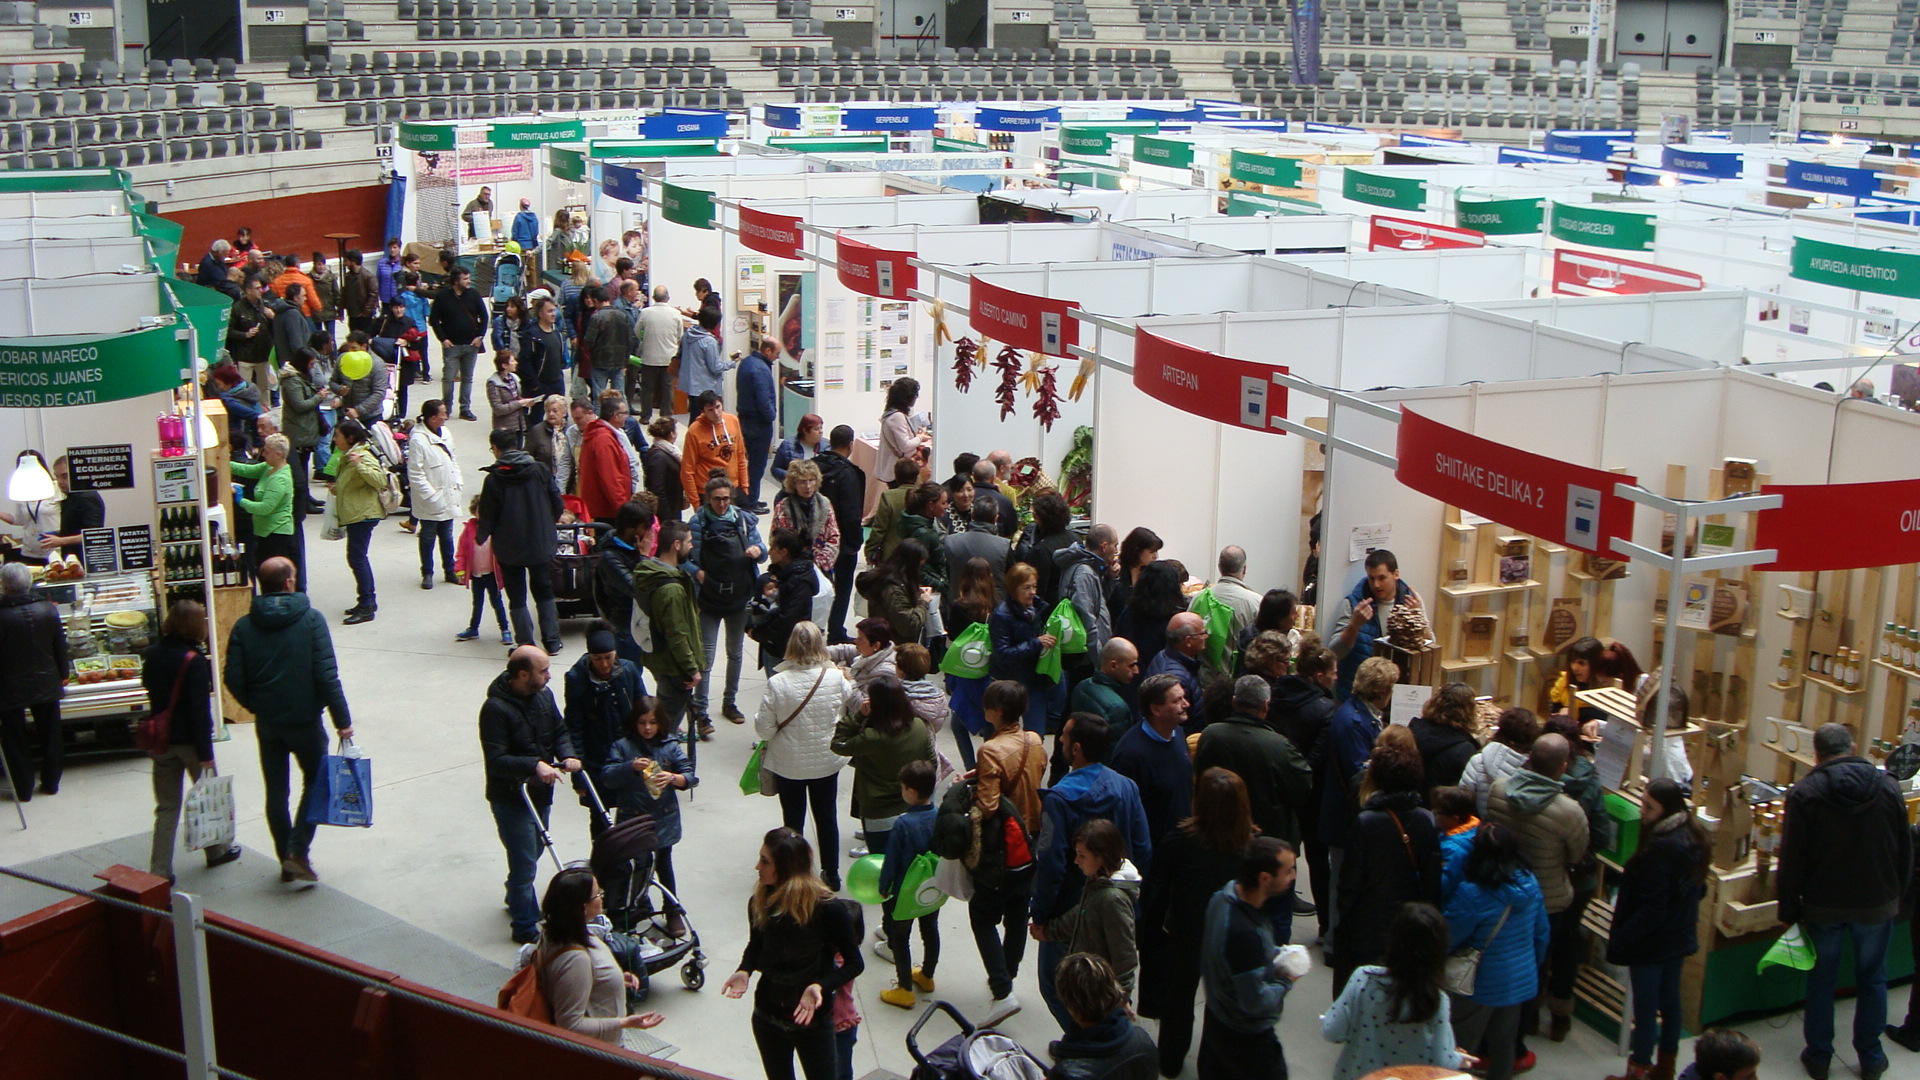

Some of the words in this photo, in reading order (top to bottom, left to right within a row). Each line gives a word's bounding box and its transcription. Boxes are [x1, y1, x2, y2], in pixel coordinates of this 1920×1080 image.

[274, 10, 284, 18] T3
[875, 116, 909, 124] SERPENSLAB
[999, 116, 1030, 125] CARRETERA
[677, 124, 700, 133] CENSANA
[511, 131, 549, 141] NUTRIVITALIS
[560, 129, 576, 139] NEGRO
[378, 146, 391, 156] T3
[1824, 174, 1849, 187] NATURAL
[1810, 257, 1848, 275] AYURVEDA
[1850, 262, 1897, 281] AUTÉNTICO
[979, 300, 1000, 322] ALBERTO
[1000, 307, 1027, 329] CAMINO
[42, 346, 98, 364] MARECO
[53, 367, 103, 385] JUANES
[1162, 364, 1198, 391] ARTEPAN
[45, 392, 63, 407] DE
[67, 390, 96, 405] CATI
[69, 446, 131, 456] HAMBURGUESA
[86, 455, 128, 464] TERNERA
[1435, 452, 1484, 488] SHIITAKE
[1488, 471, 1533, 505] DELIKA
[1536, 487, 1544, 508] 2
[120, 529, 149, 537] PATATAS
